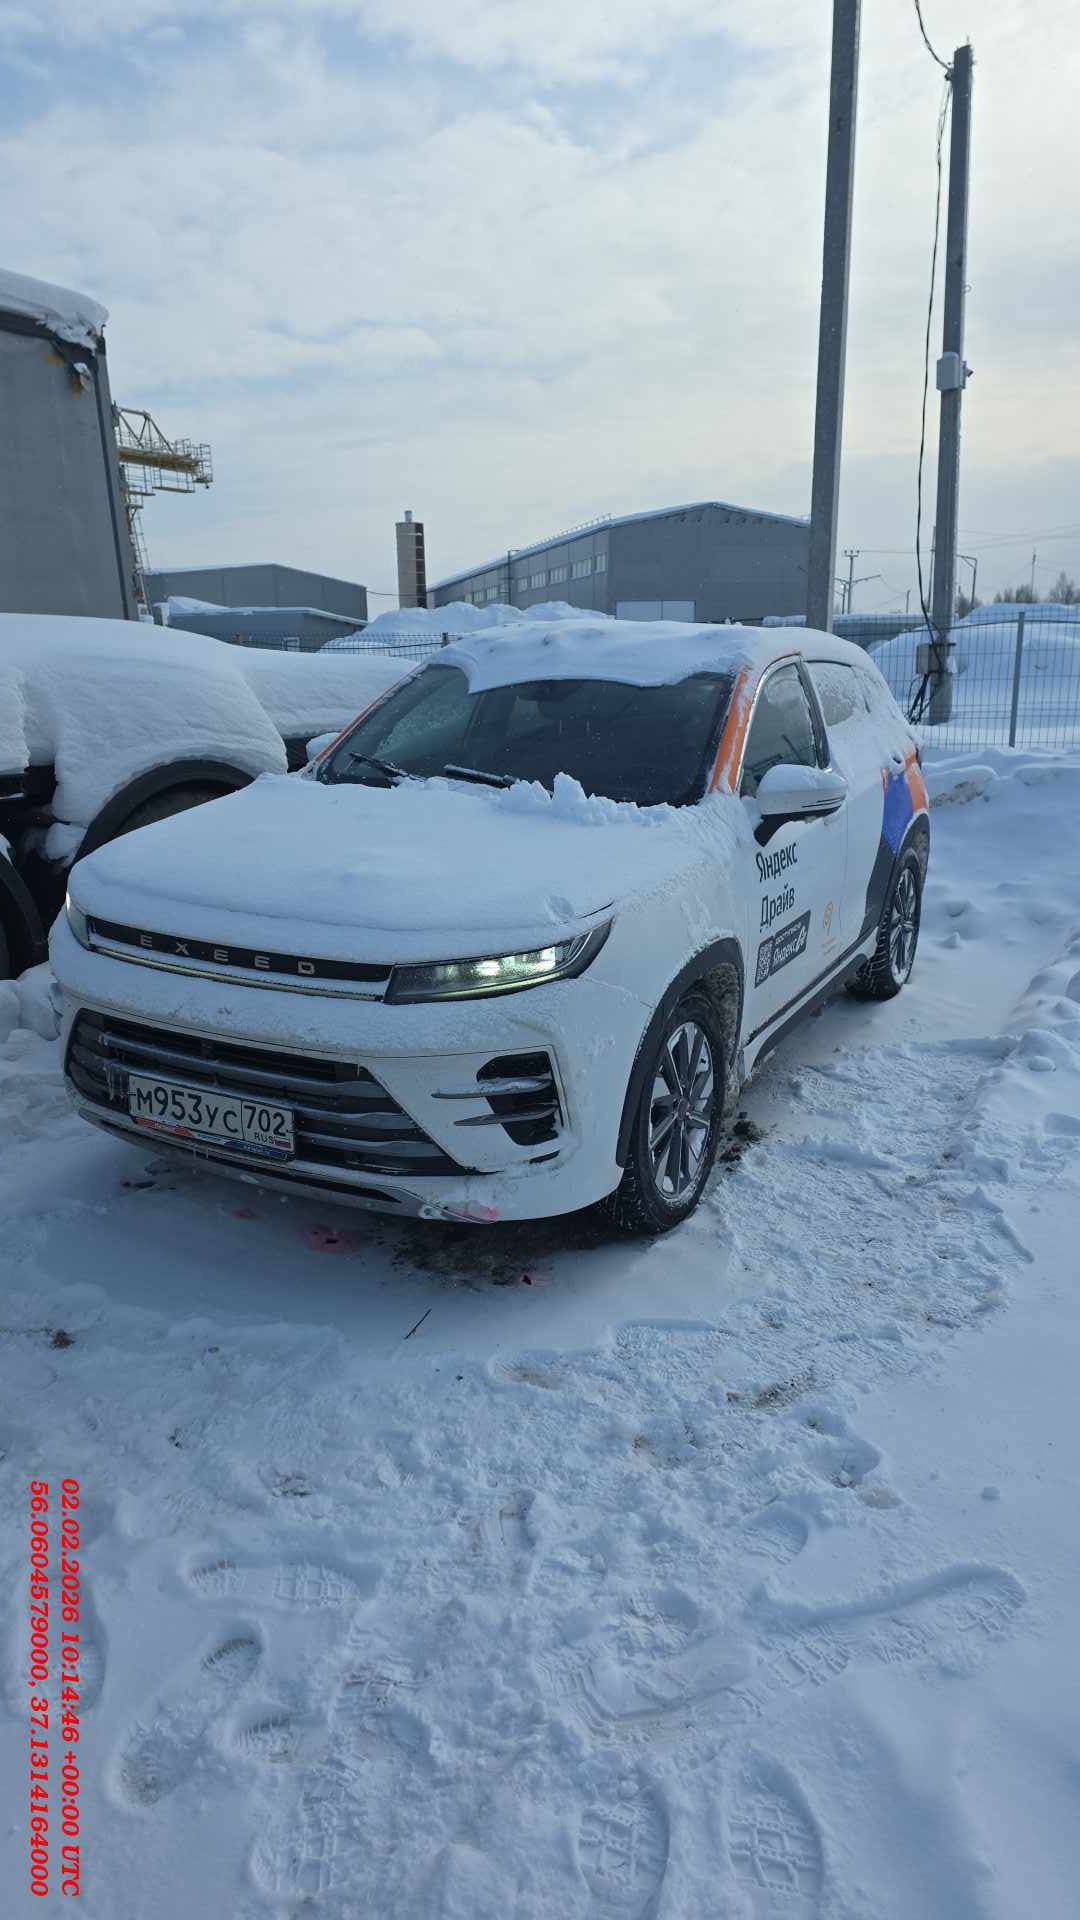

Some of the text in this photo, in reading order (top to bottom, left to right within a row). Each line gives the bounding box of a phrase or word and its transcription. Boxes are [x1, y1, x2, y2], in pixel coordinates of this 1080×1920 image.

[756, 842, 798, 883] Яндекс
[760, 883, 795, 933] Драйв
[139, 934, 316, 976] EXEED
[244, 1104, 287, 1138] 702
[254, 1131, 275, 1145] RUS
